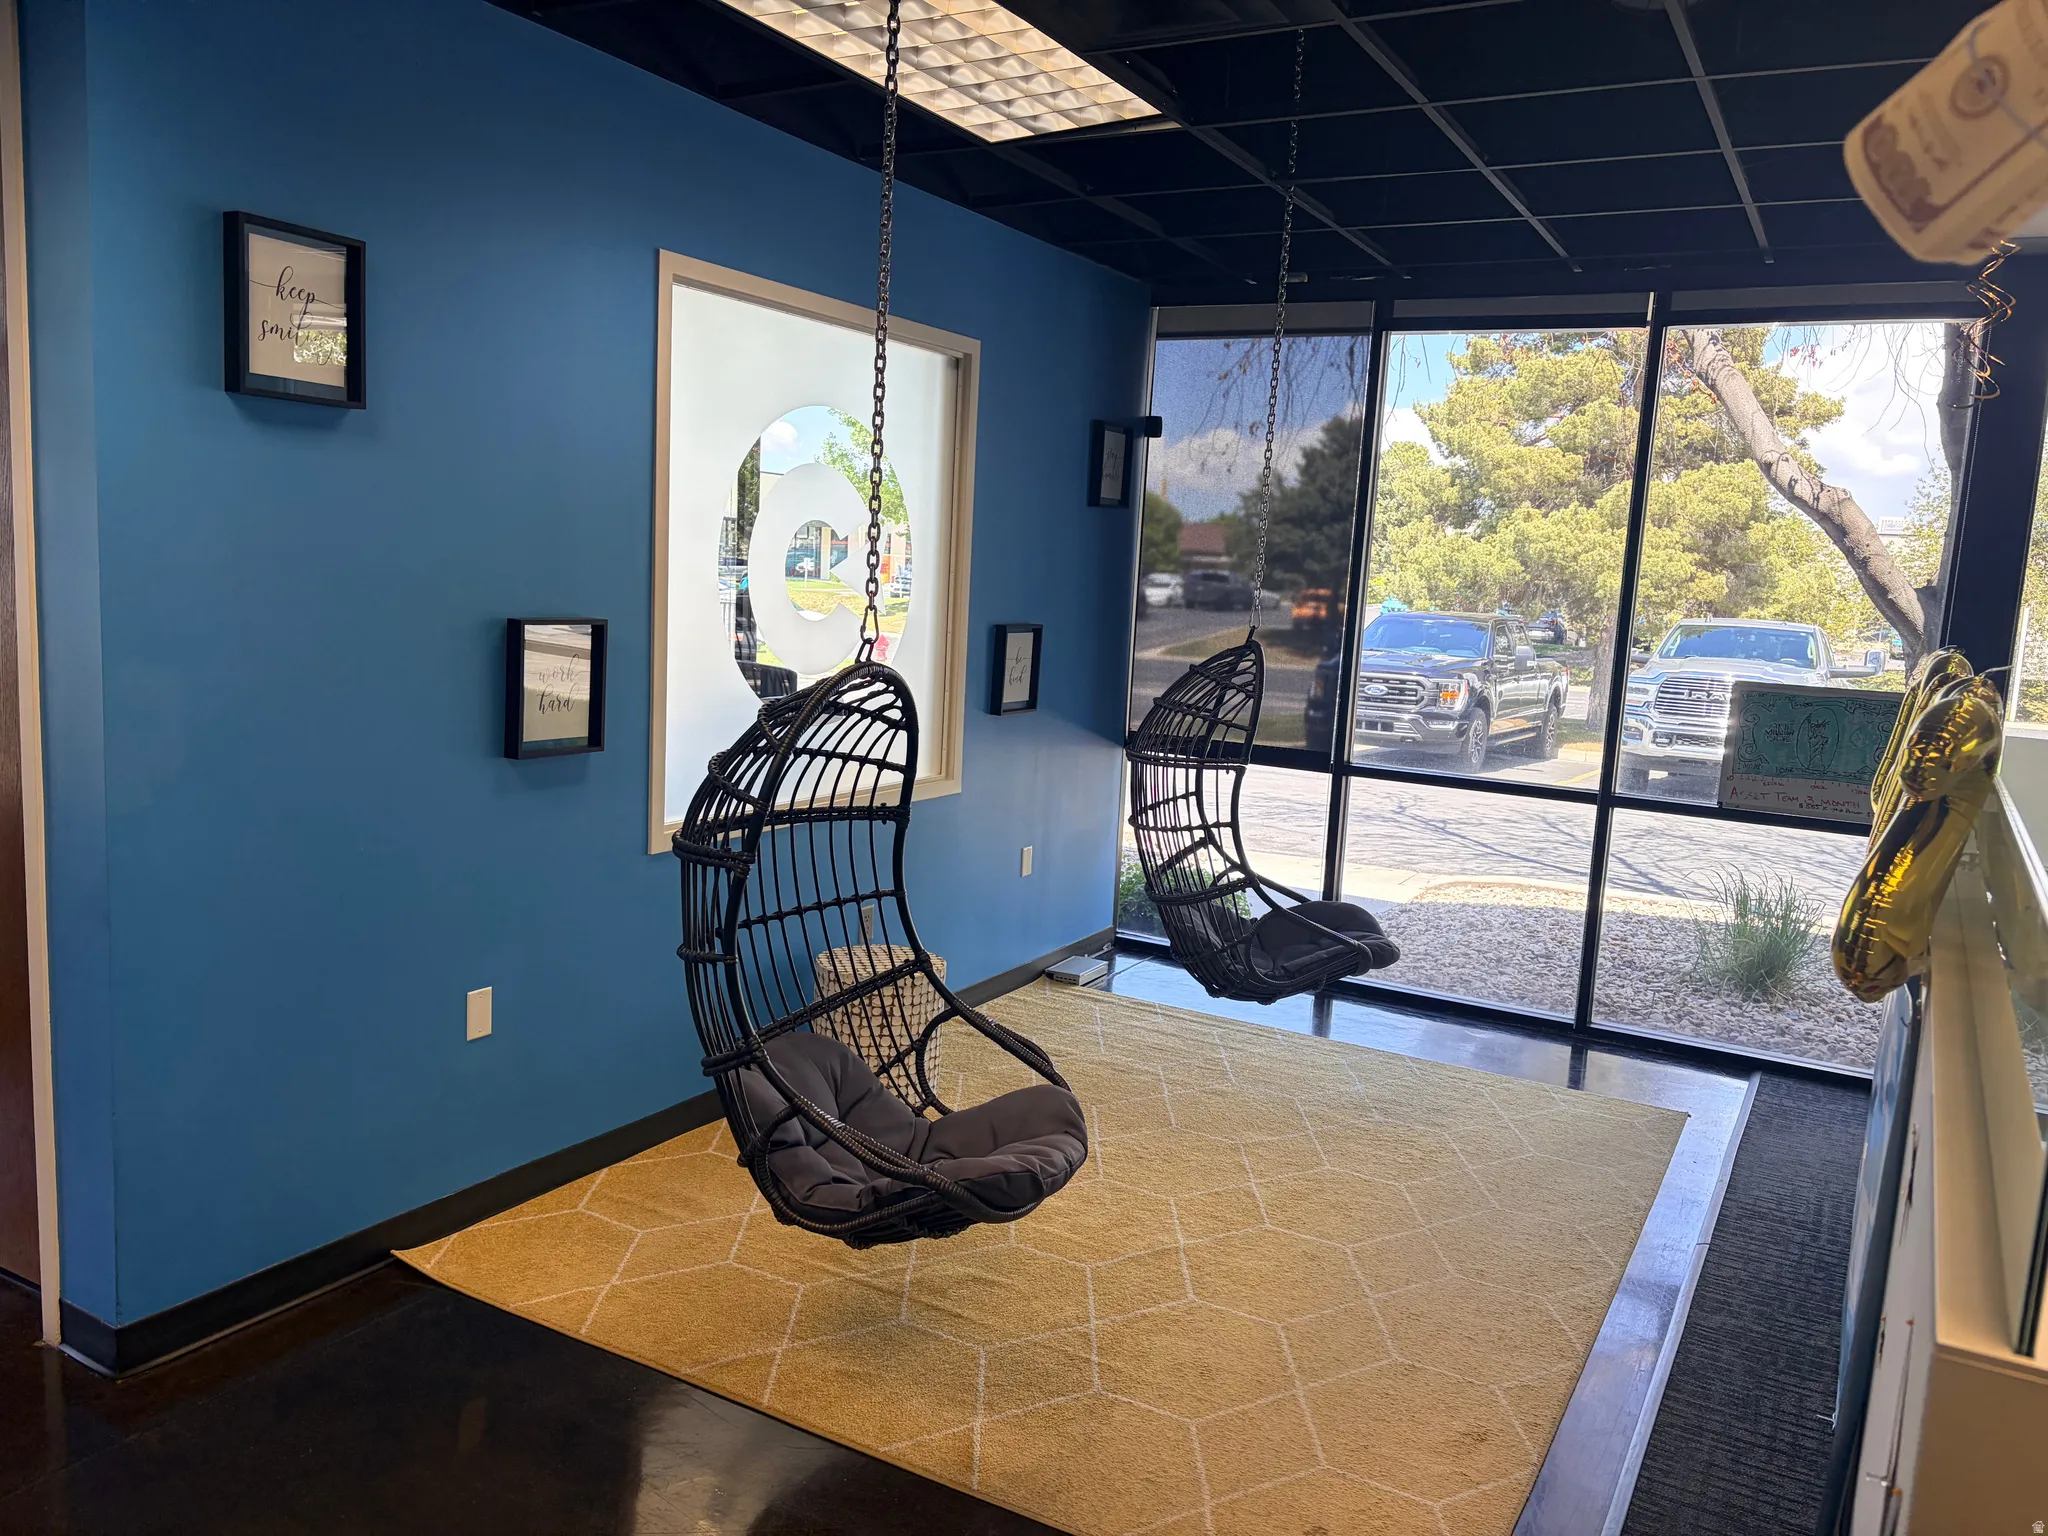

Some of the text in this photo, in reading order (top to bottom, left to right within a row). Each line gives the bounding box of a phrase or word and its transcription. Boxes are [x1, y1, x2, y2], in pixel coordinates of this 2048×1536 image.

[537, 653, 580, 684] work
[536, 683, 580, 715] hard
[1775, 791, 1799, 802] TEAM
